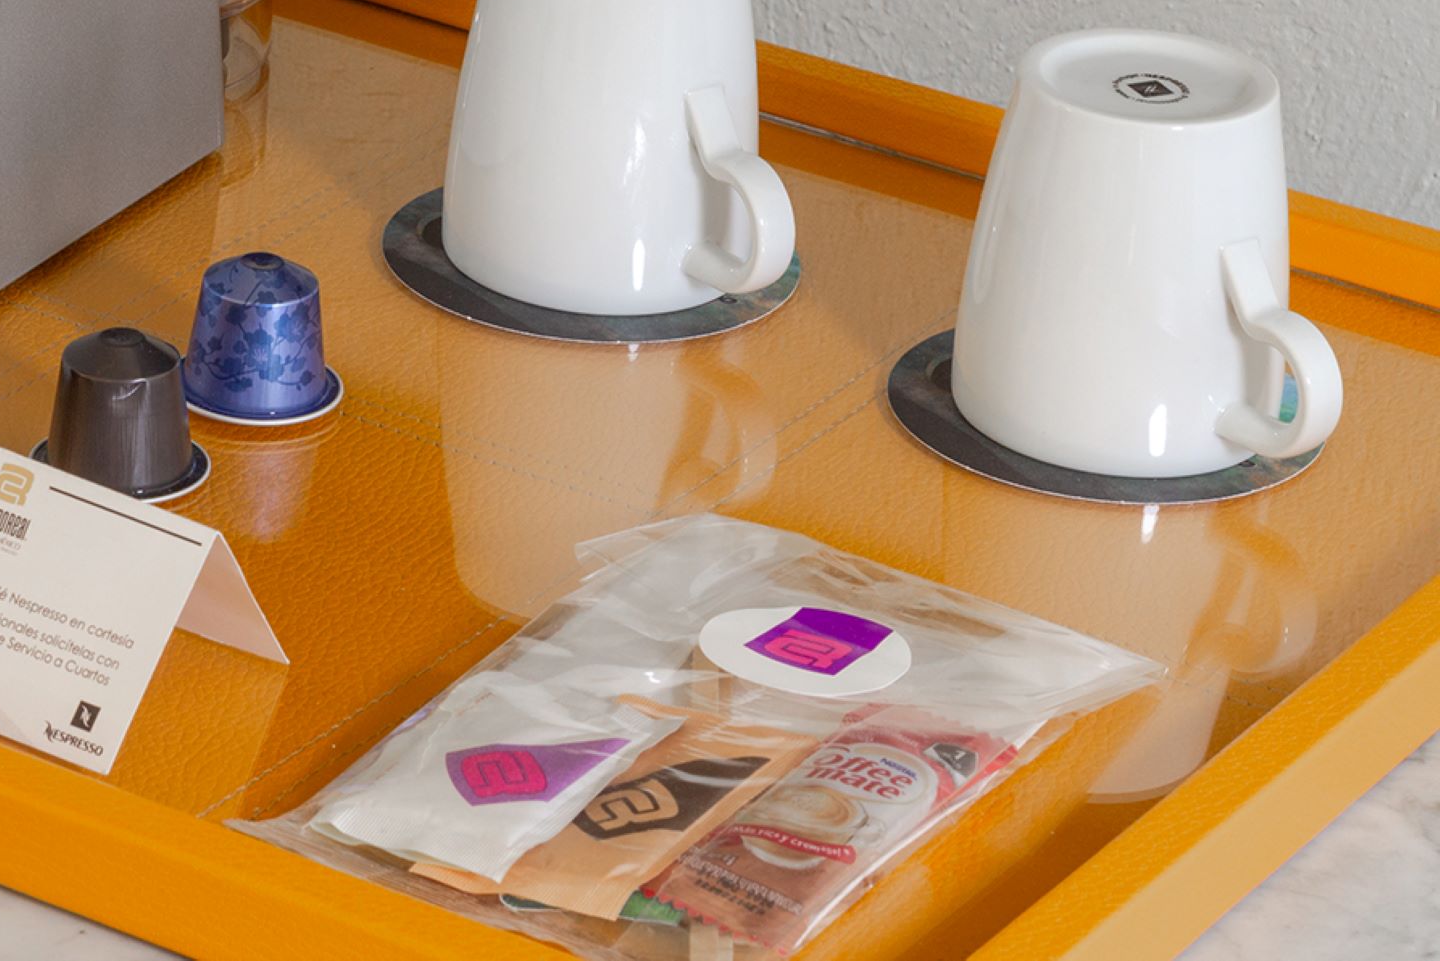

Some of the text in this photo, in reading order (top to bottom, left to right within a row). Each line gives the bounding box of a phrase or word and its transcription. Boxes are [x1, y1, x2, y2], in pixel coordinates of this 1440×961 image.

[9, 592, 68, 624] Nespresso
[69, 617, 86, 631] en
[87, 624, 135, 649] cortesía
[7, 635, 54, 664] Servicio
[54, 657, 64, 669] a
[65, 659, 110, 687] Cuartos
[96, 654, 120, 671] con
[43, 719, 105, 757] NESPRESSO
